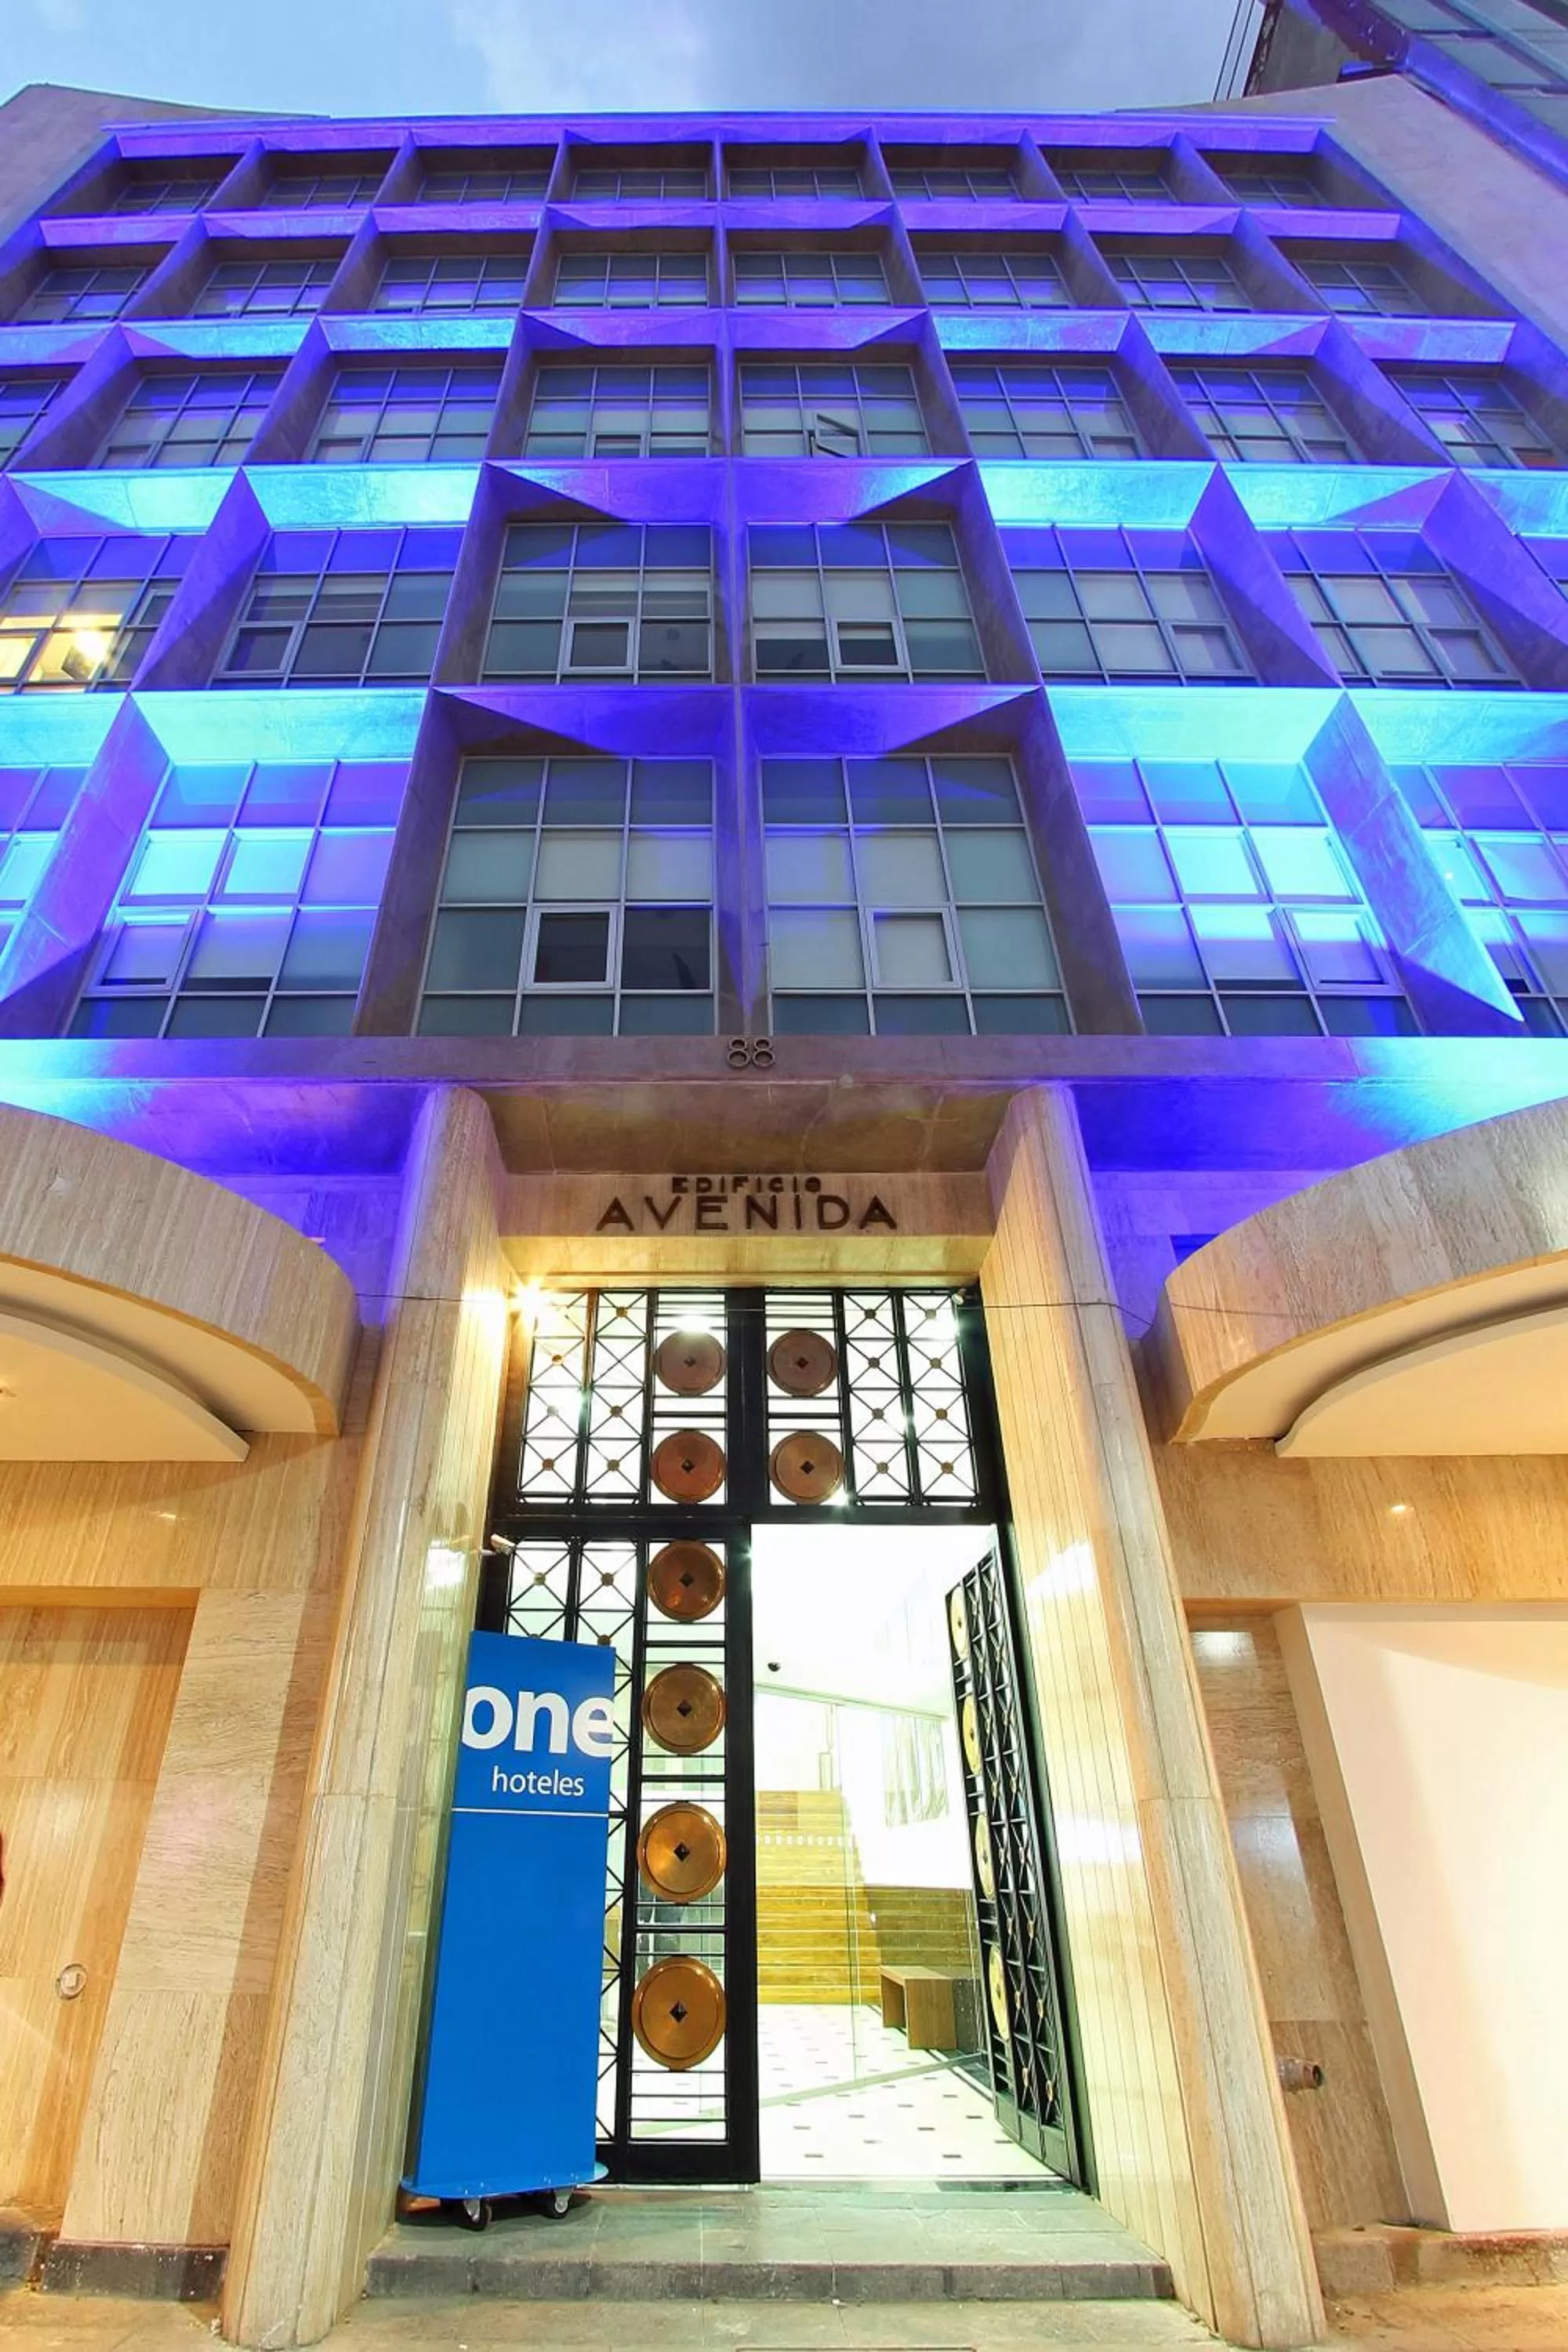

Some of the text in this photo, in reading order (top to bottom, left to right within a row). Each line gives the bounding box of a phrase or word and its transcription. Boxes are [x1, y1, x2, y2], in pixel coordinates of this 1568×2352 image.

[727, 1037, 775, 1068] 88
[672, 1177, 821, 1193] EDIFICIO
[596, 1196, 897, 1231] AVENIDA
[462, 1686, 614, 1758] one
[492, 1765, 584, 1796] hoteles
